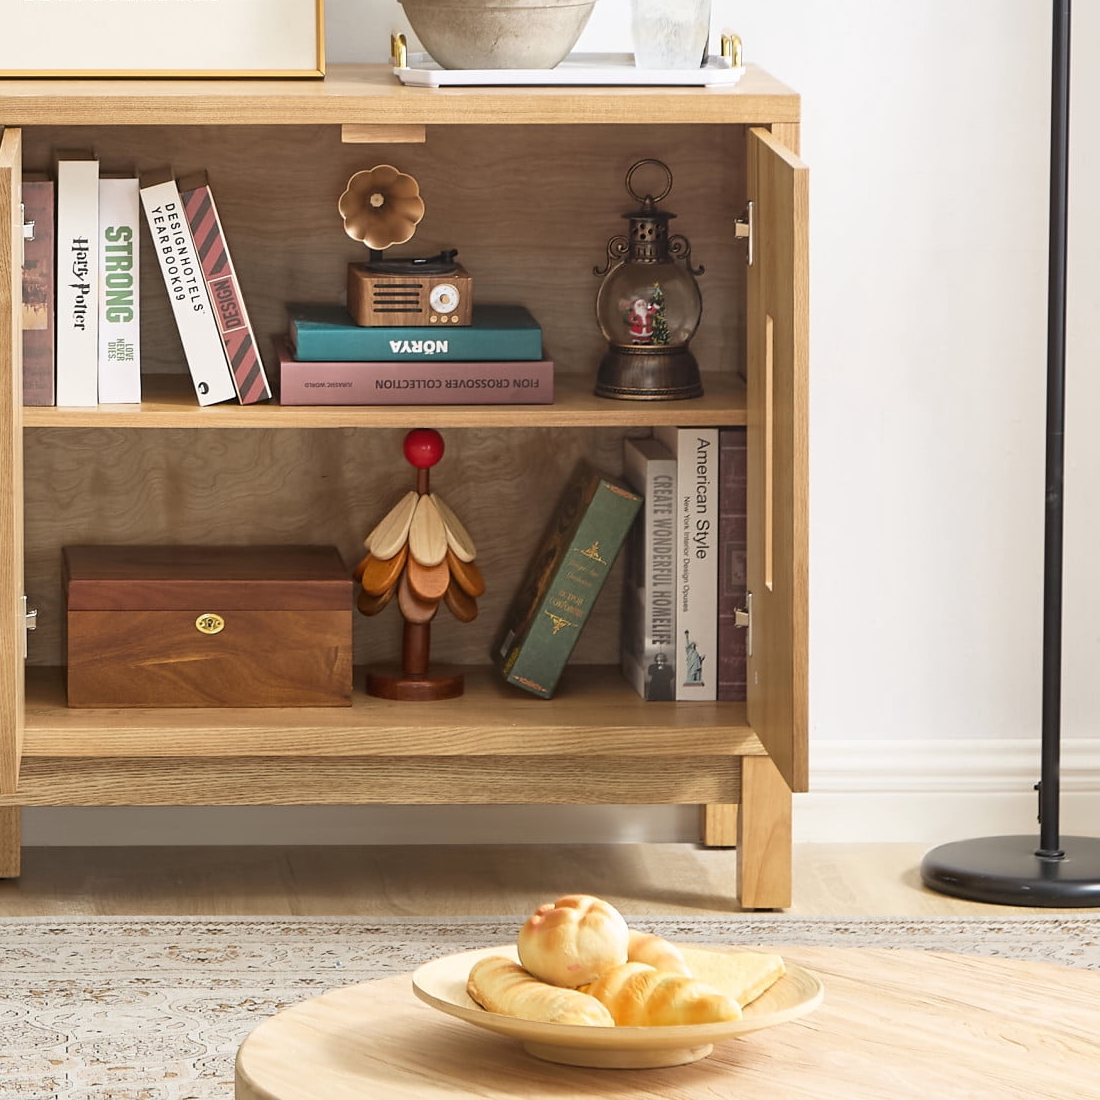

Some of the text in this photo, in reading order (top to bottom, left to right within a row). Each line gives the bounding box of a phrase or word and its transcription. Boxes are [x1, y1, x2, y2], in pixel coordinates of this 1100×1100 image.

[68, 235, 90, 331] Harry Potter
[104, 225, 134, 324] STRONG
[214, 279, 242, 329] DESIGN
[108, 341, 116, 362] DIES.
[116, 338, 125, 362] NEVER
[125, 343, 134, 362] LOVE
[375, 378, 443, 389] COLLECTION
[445, 378, 510, 389] CROSSOVER
[512, 378, 540, 389] FION
[694, 437, 710, 560] American Style
[651, 474, 673, 645] CREATE WONDERFUL HOMELIFE
[683, 558, 691, 583] Design
